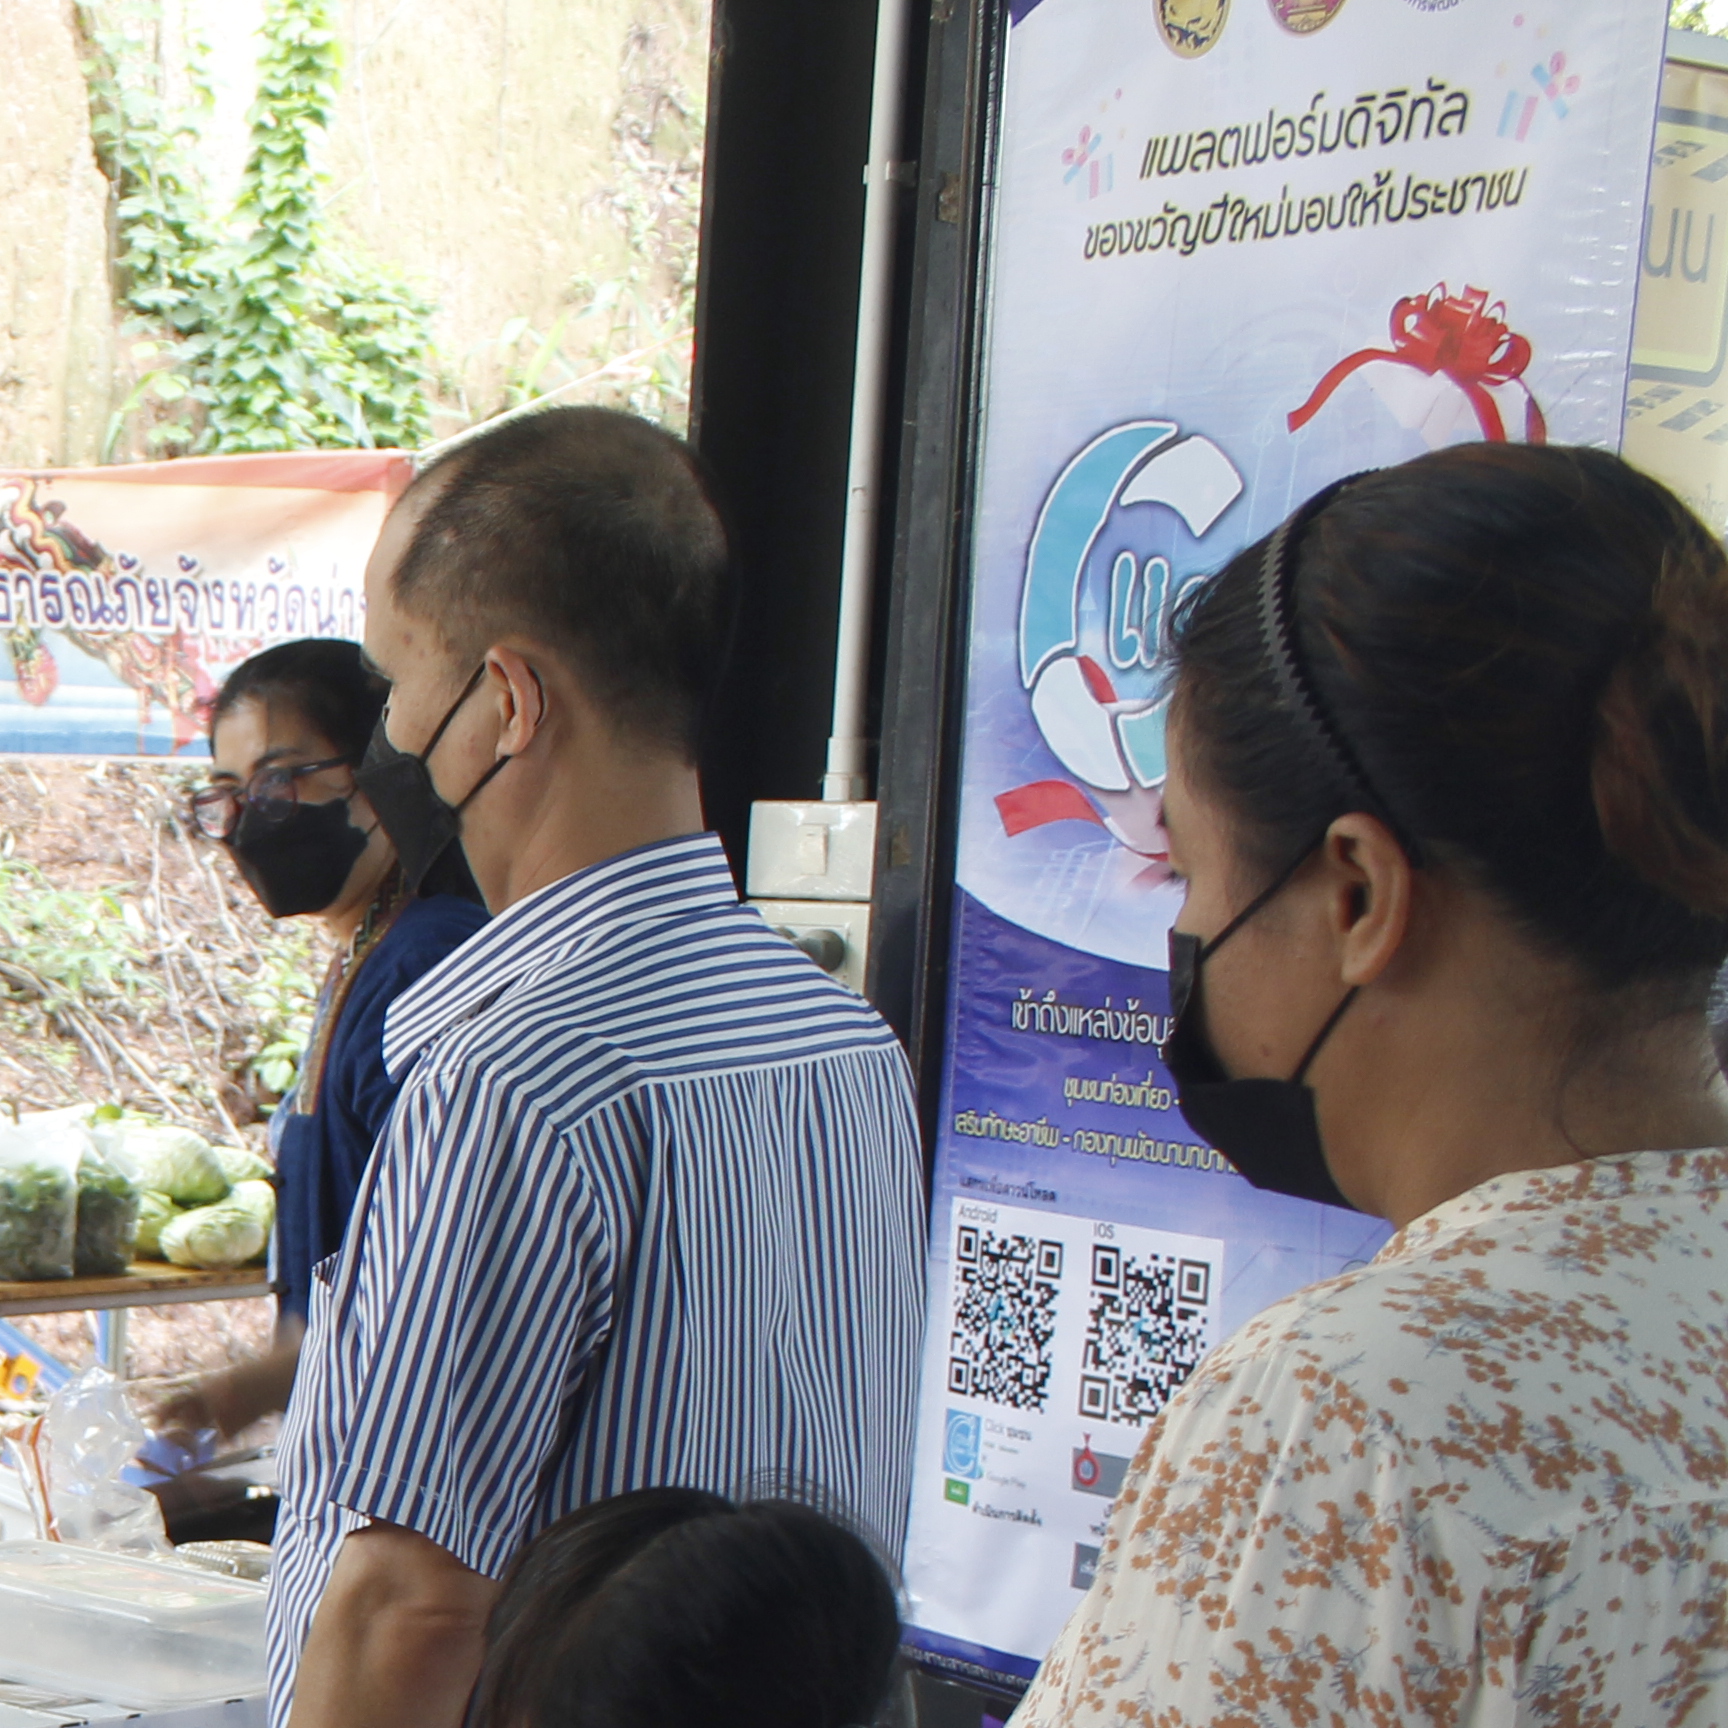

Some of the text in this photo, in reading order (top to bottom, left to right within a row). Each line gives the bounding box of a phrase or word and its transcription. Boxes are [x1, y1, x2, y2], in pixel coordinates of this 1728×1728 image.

[1138, 77, 1471, 182] แพลตฟอร์มดิจิทัล
[1083, 166, 1528, 261] ของขวัญปีใหม่มอบให้ประชาชน
[1064, 1072, 1171, 1112] ชุมชนท่องเที่ยว
[959, 1205, 997, 1223] Android
